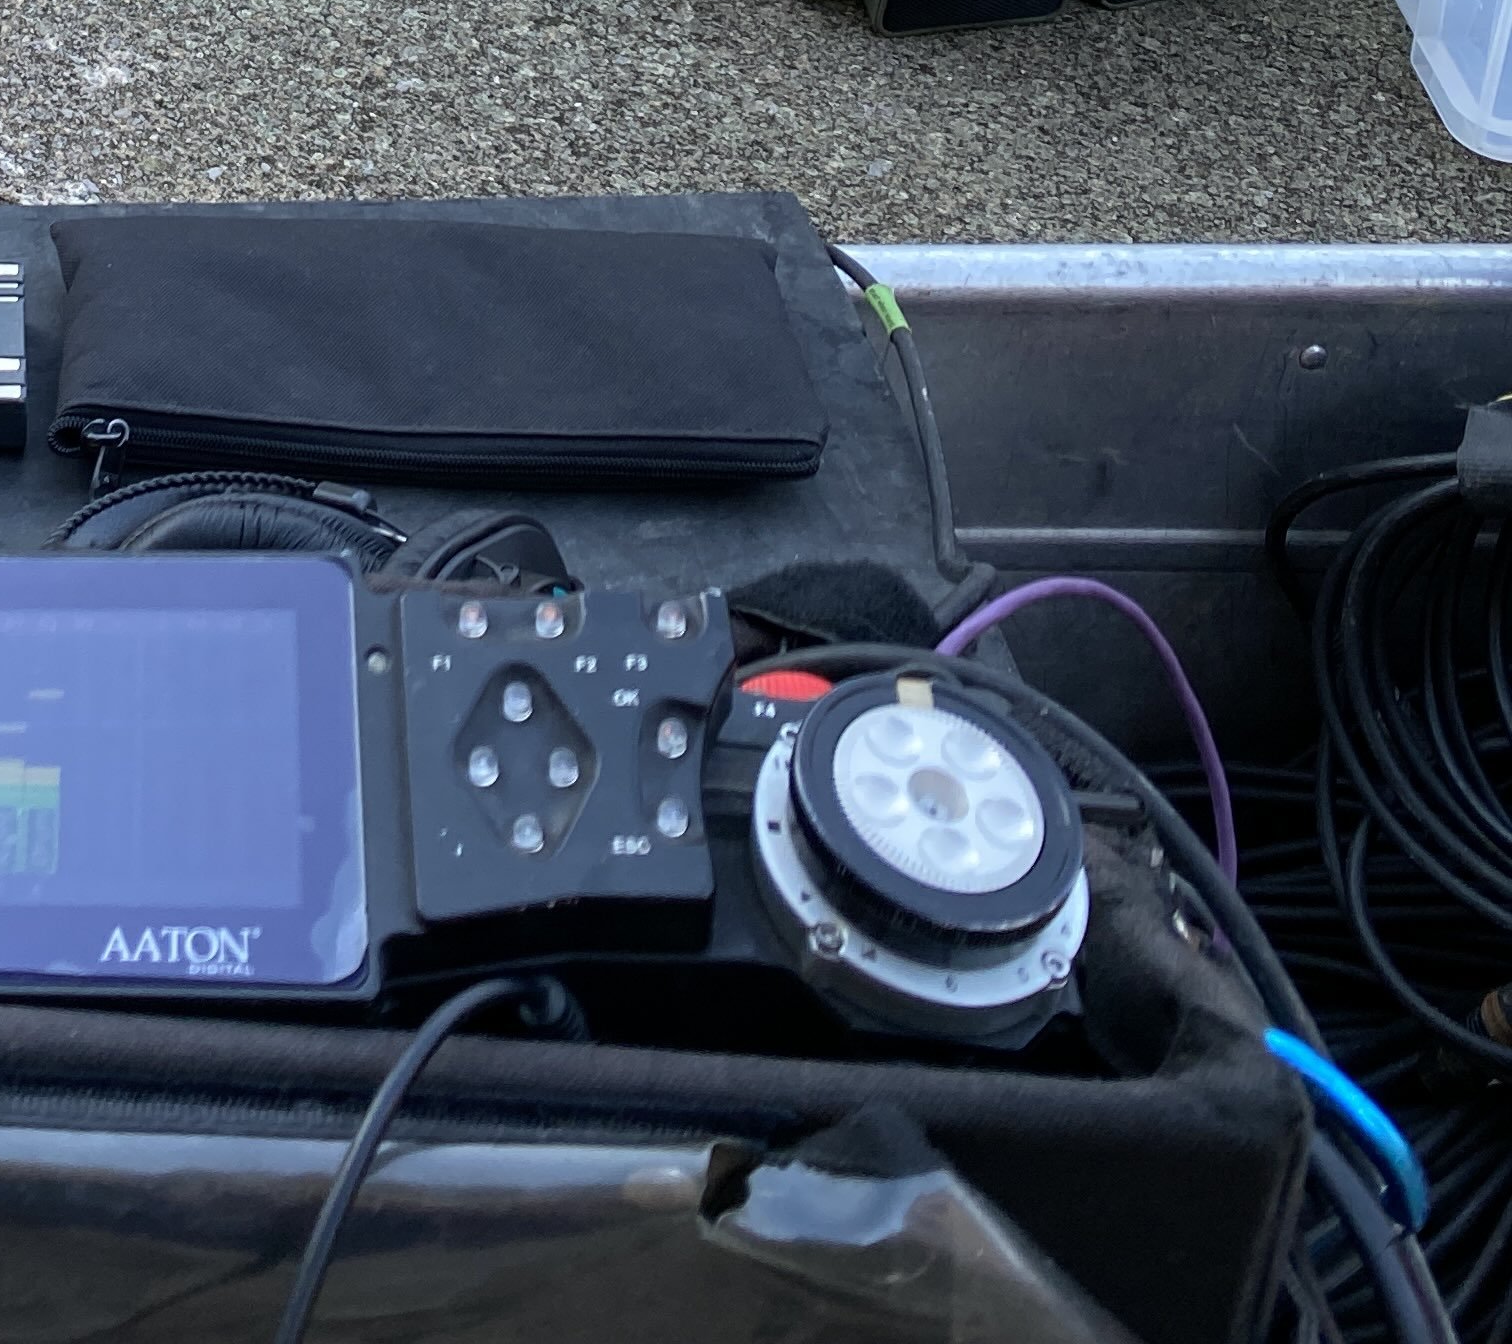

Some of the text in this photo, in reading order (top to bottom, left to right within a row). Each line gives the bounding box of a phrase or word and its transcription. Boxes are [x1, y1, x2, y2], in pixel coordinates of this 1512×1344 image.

[432, 654, 451, 672] F1
[575, 655, 597, 673] F2
[625, 653, 648, 672] F3
[612, 688, 639, 707] OK
[754, 701, 776, 719] F4
[612, 835, 651, 855] ESC
[99, 926, 253, 963] AATON
[187, 963, 255, 977] DIGITAL
